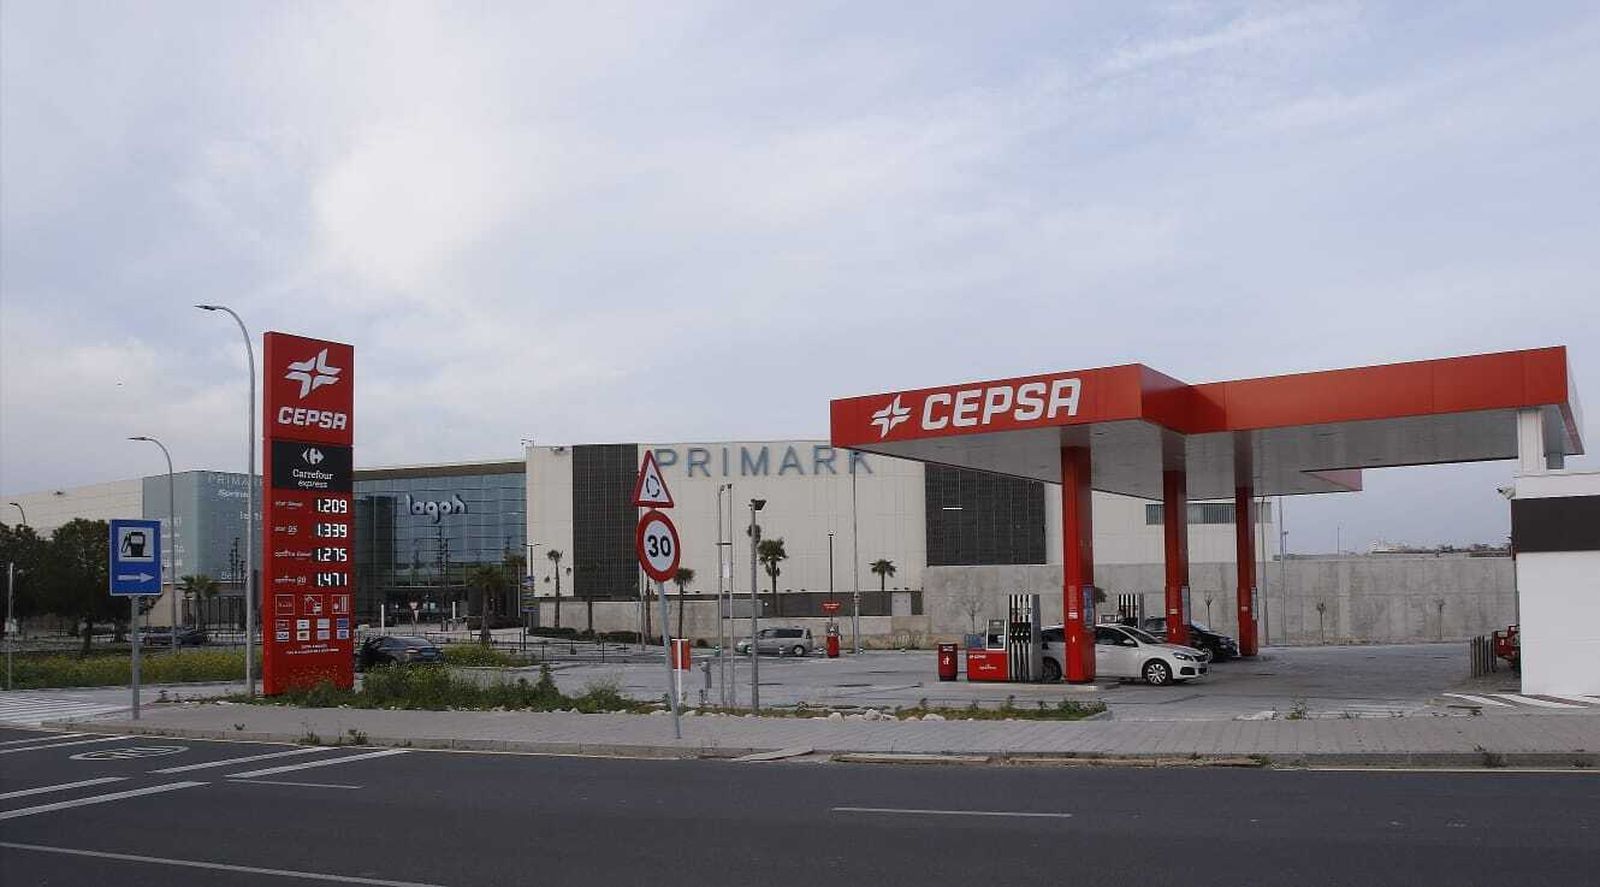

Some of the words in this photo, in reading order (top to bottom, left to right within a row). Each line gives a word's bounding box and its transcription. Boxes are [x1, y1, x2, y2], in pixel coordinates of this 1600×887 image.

[922, 378, 1082, 431] CEPSA
[278, 406, 348, 430] CEPSA
[654, 445, 875, 478] PRIMARK
[292, 468, 334, 480] Carrefour
[317, 498, 347, 514] 1.209
[406, 493, 466, 524] lagoh
[317, 523, 347, 538] 1.339
[317, 548, 347, 562] 1.275
[647, 534, 672, 558] 30
[317, 572, 347, 587] 1.471
